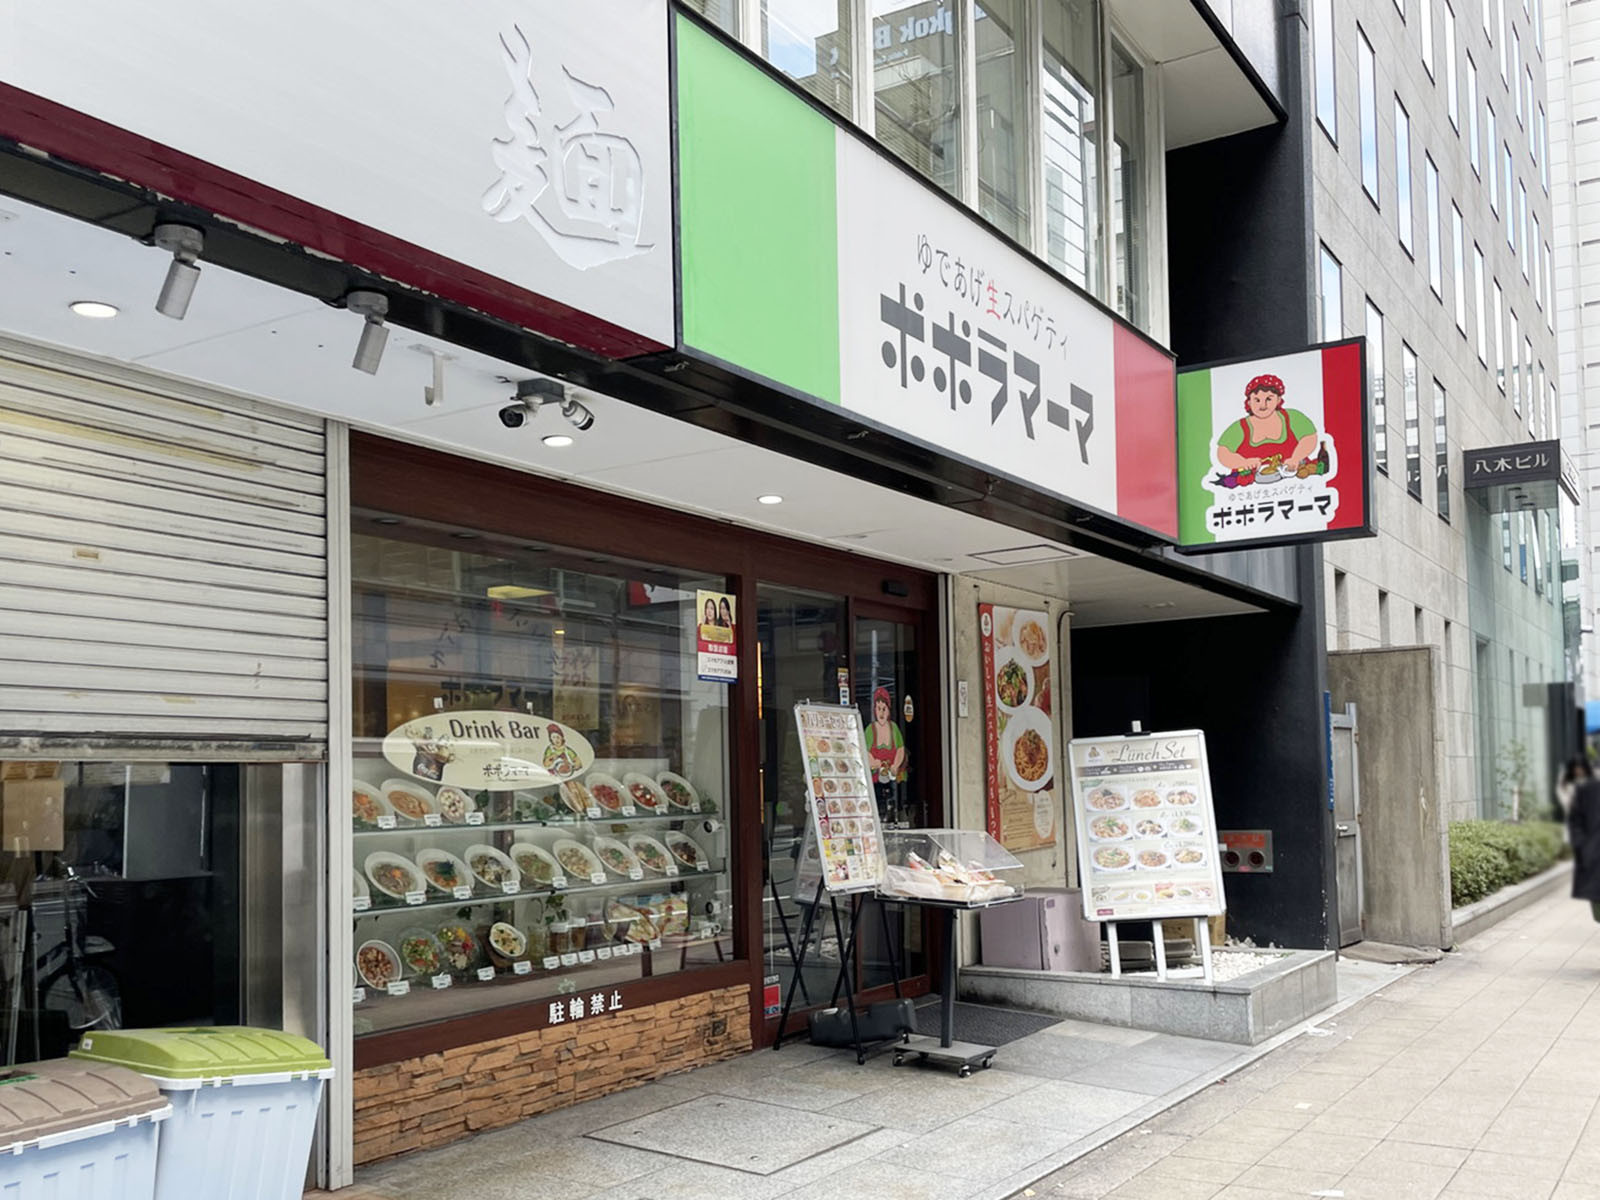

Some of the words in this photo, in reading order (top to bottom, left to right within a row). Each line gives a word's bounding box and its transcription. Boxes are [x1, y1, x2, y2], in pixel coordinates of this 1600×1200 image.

[917, 234, 1068, 360] ゆであげ生スパゲティ
[1473, 453, 1550, 475] 八木ビル
[449, 719, 505, 740] Drink
[508, 720, 541, 741] Bar
[1112, 741, 1161, 763] Lunch
[1161, 740, 1186, 761] Set
[548, 990, 623, 1025] 駐輪禁止
